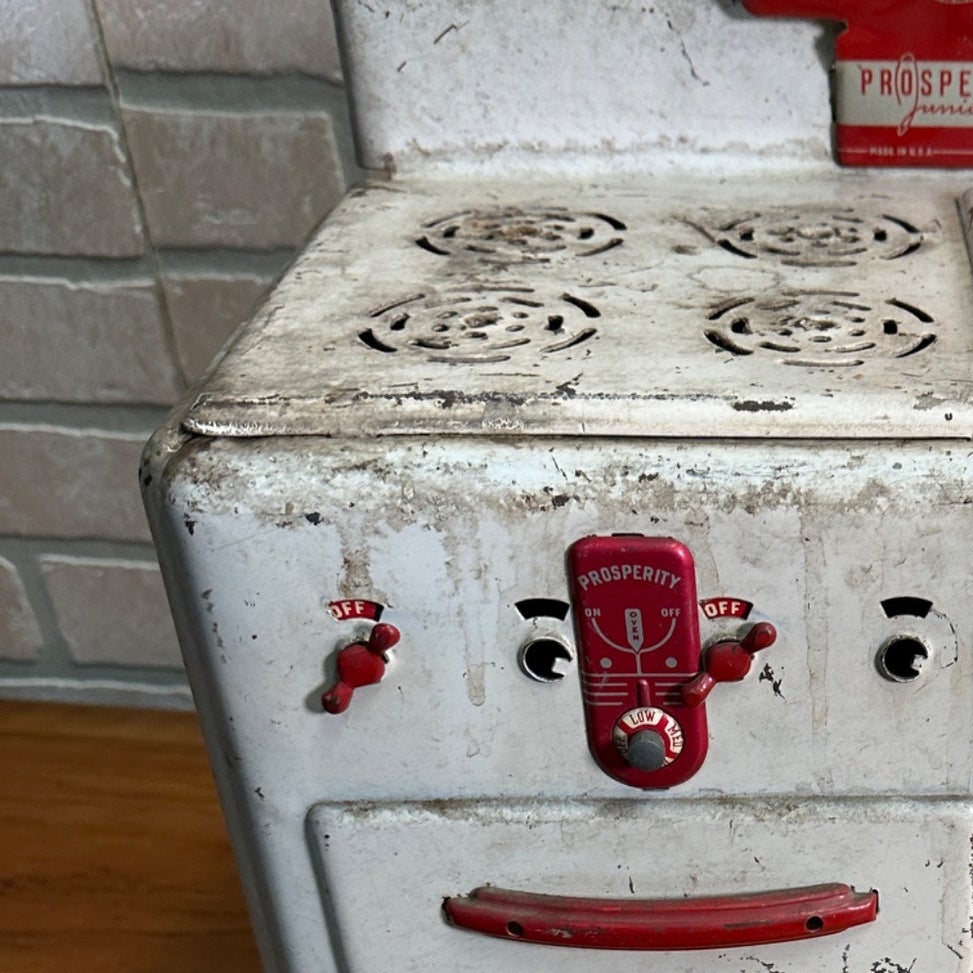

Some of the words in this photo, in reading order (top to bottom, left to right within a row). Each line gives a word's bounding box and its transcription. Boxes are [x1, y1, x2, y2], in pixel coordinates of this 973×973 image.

[577, 564, 682, 591] PROSPERITY
[330, 601, 365, 619] OFF
[584, 607, 601, 618] ON
[660, 607, 681, 618] OFF
[704, 601, 741, 618] OFF
[629, 610, 640, 642] OVEN
[629, 710, 656, 726] LOW
